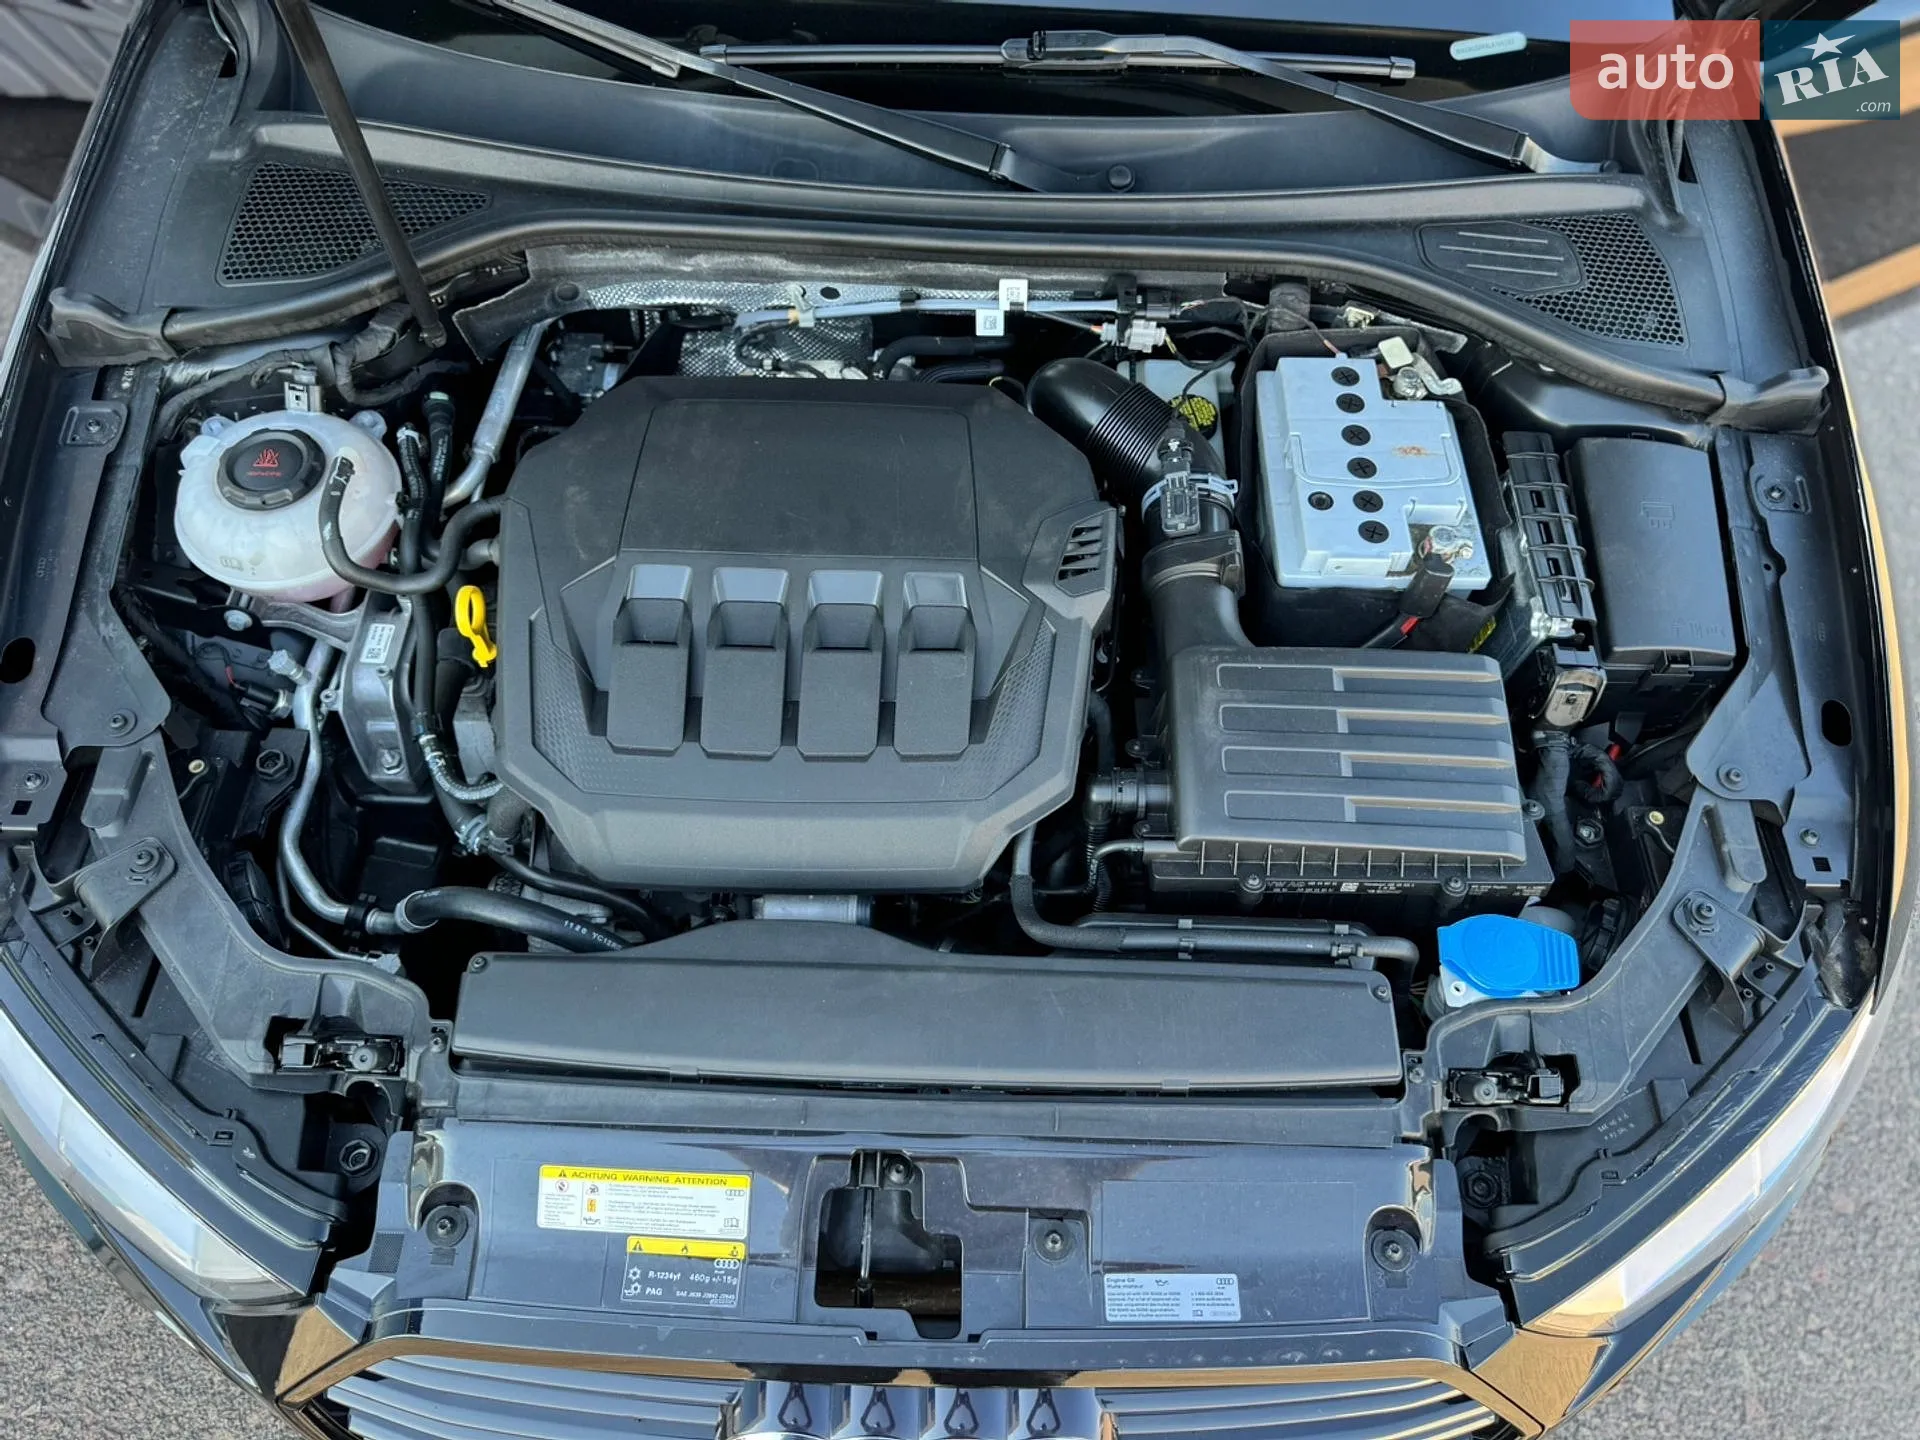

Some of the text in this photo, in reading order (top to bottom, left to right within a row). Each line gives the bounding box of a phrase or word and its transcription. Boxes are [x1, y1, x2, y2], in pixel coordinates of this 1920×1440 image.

[571, 1171, 727, 1187] ACHTUNG WARNING ATTENTION
[647, 1270, 681, 1281] R-1234yf
[645, 1286, 663, 1296] PAG
